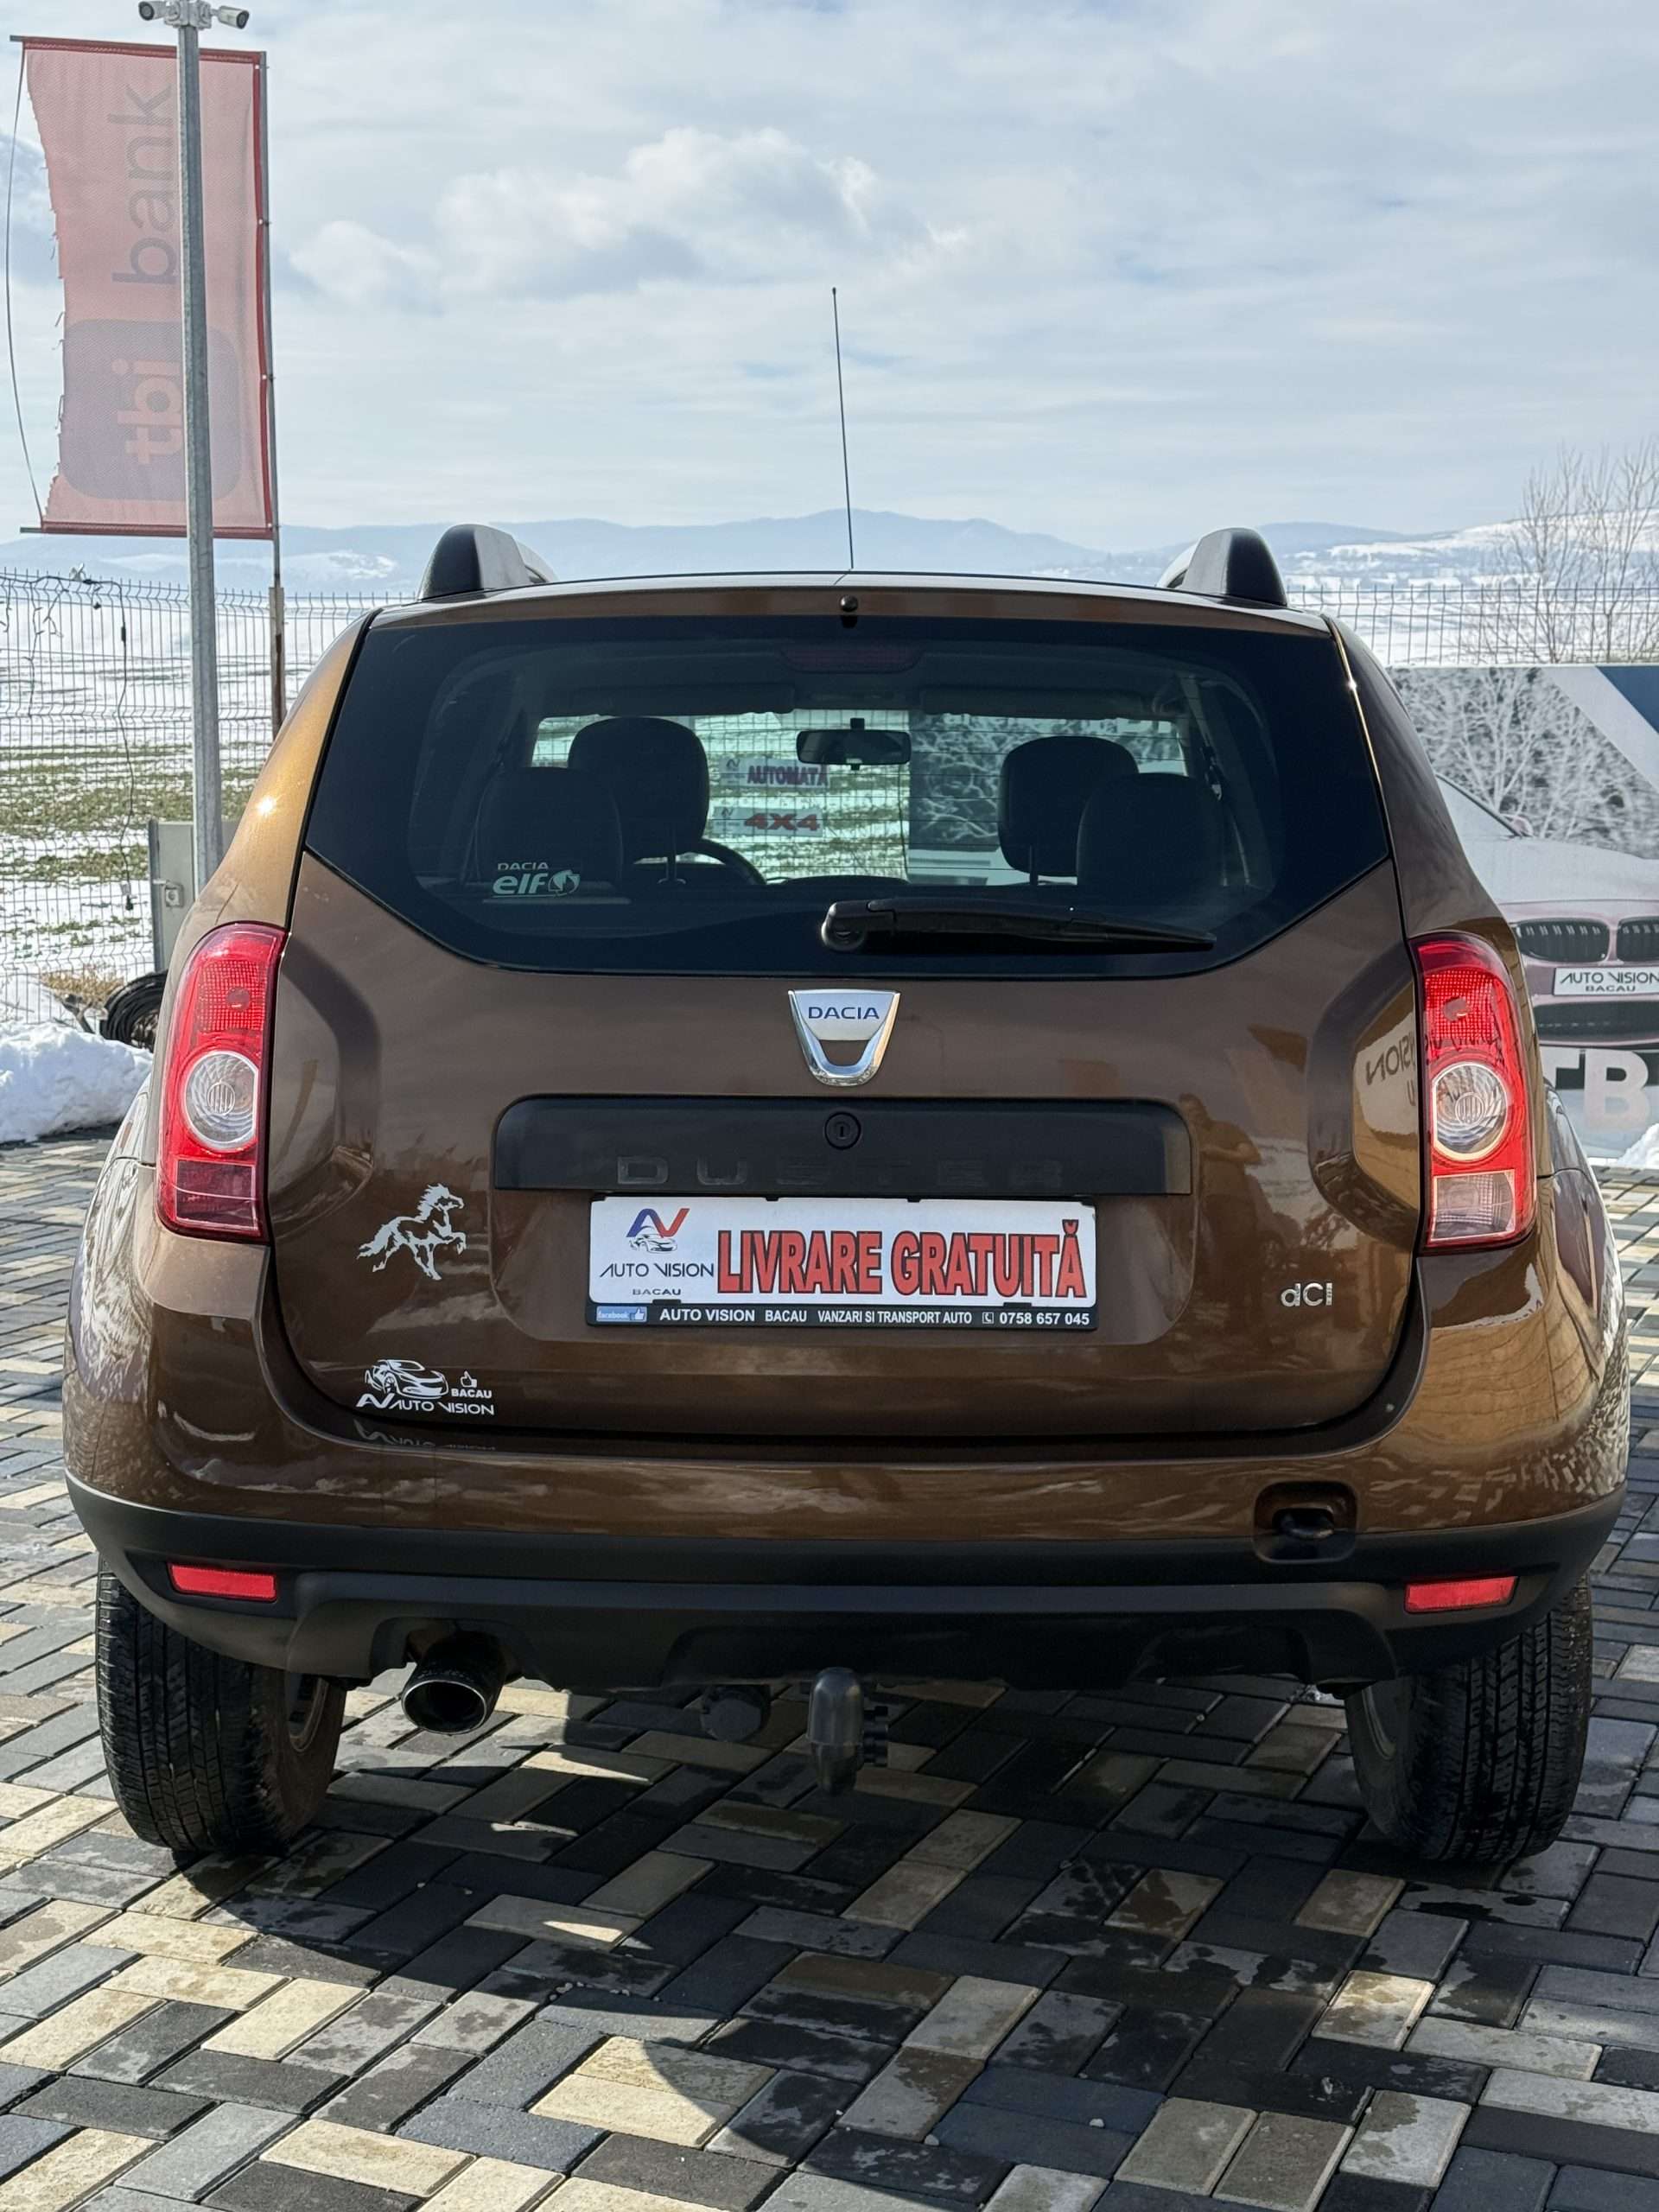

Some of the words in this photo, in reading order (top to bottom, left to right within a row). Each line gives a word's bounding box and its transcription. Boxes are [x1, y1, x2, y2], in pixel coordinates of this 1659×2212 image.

[108, 85, 177, 284] bank
[111, 358, 183, 467] tbi
[497, 861, 550, 871] DACIA
[493, 873, 549, 894] elf
[1560, 972, 1604, 984] AUTO
[808, 1007, 880, 1020] DACIA
[717, 1230, 883, 1294] LIVRARE
[891, 1218, 1088, 1298] GRATUITĂ
[600, 1263, 649, 1277] AUTO
[653, 1263, 714, 1278] VISION
[632, 1287, 681, 1296] BACAU
[659, 1309, 702, 1321] AUTO
[705, 1309, 755, 1322] VISION
[765, 1310, 807, 1322] BACAU
[817, 1311, 862, 1323] VANZARI
[865, 1311, 875, 1323] SI
[877, 1311, 940, 1324] TRANSPORT
[943, 1312, 972, 1324] AUTO
[999, 1313, 1033, 1325] 0758
[1036, 1313, 1063, 1325] 657
[1065, 1313, 1090, 1325] 045
[451, 1388, 492, 1399] BACAU
[389, 1400, 435, 1412] AUTO
[437, 1402, 494, 1415] VISION
